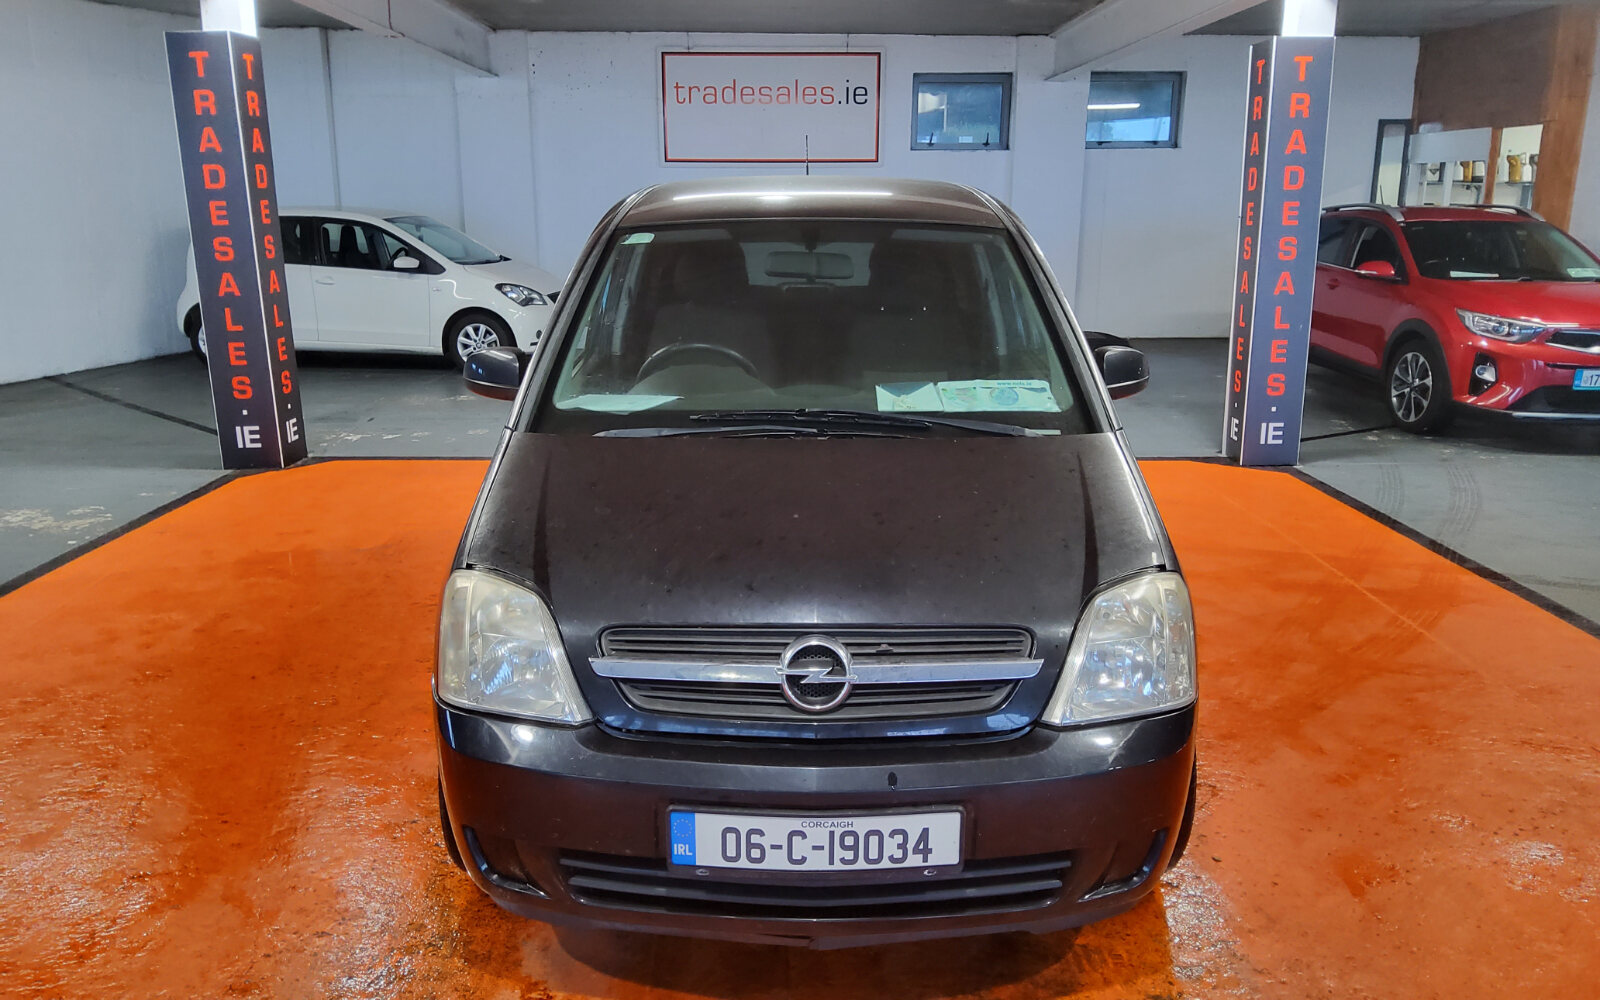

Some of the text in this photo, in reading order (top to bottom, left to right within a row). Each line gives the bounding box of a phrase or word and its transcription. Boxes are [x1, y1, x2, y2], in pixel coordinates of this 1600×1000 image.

[673, 78, 869, 105] tradesales.ie
[801, 820, 854, 829] CORCAIGH
[673, 843, 693, 856] IRL
